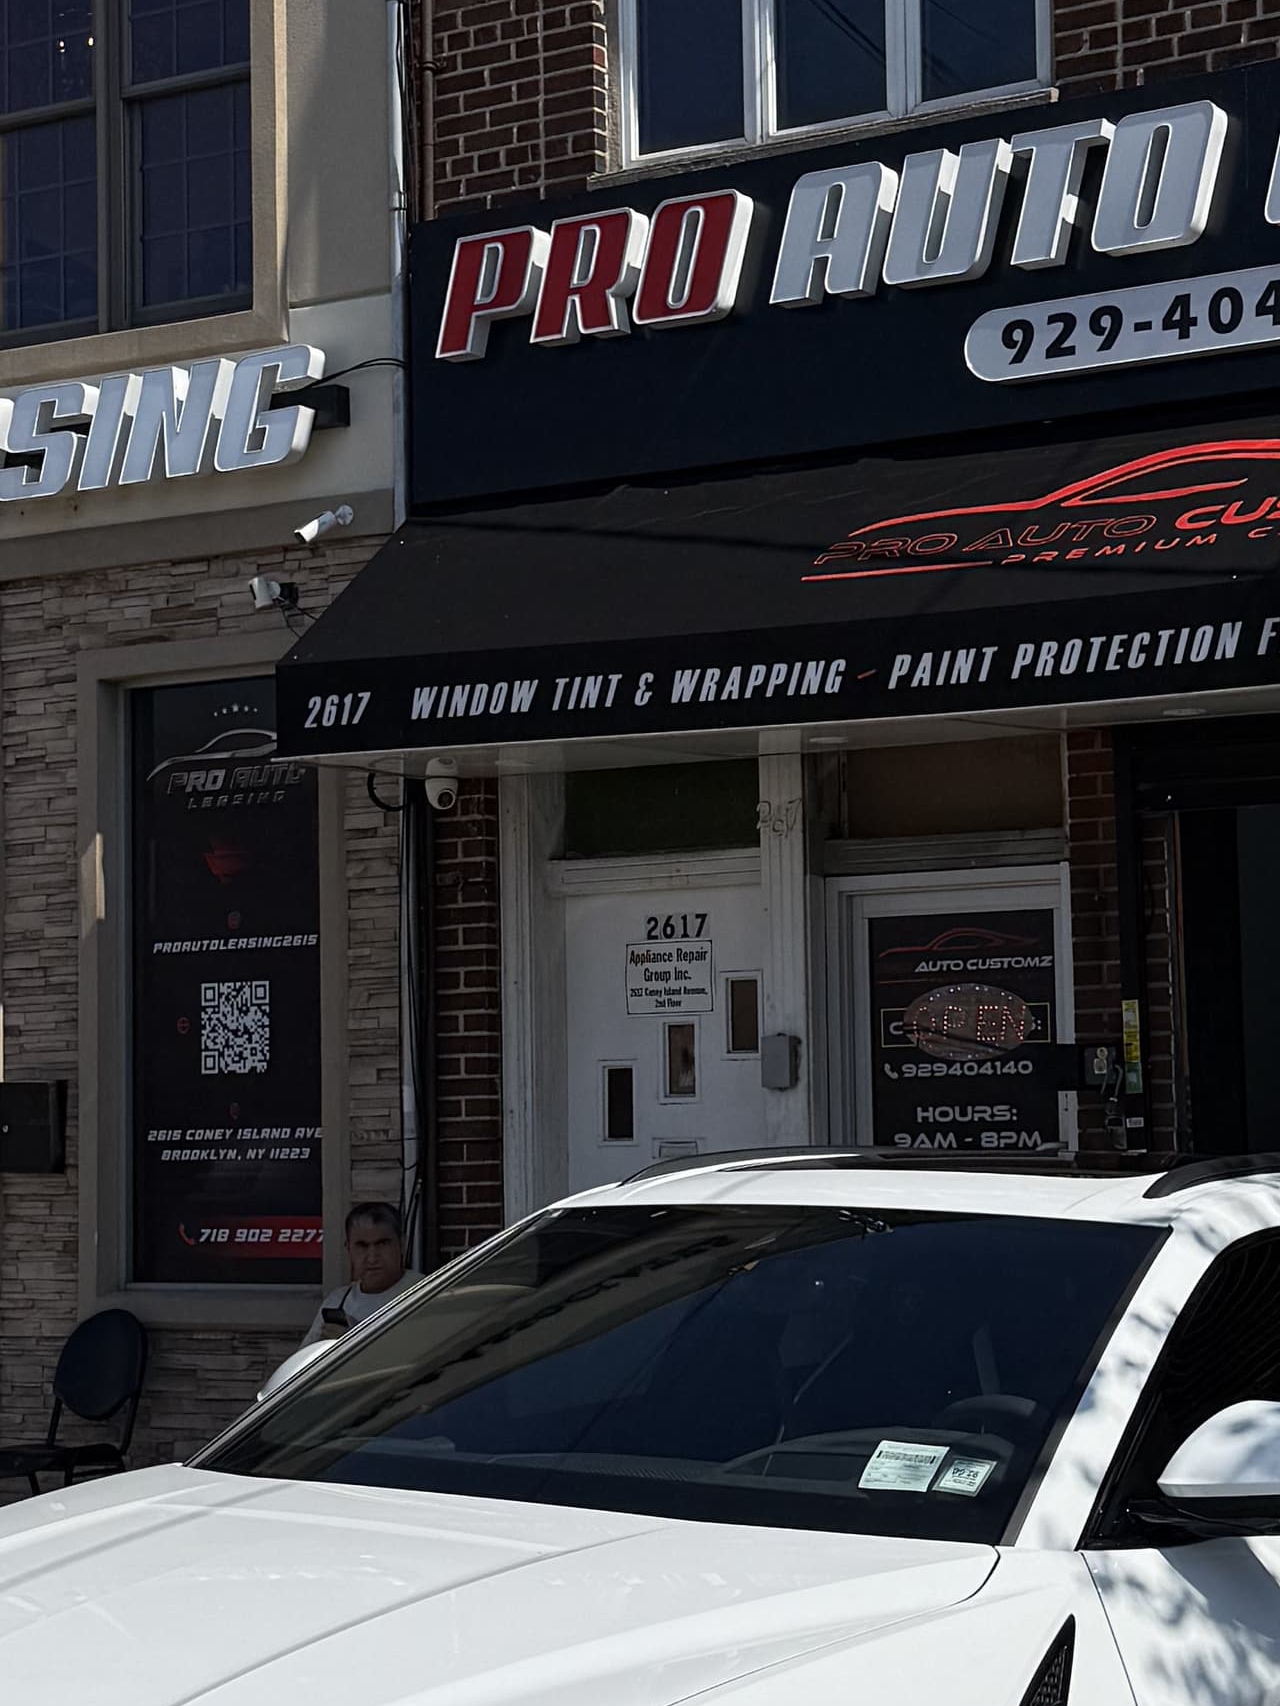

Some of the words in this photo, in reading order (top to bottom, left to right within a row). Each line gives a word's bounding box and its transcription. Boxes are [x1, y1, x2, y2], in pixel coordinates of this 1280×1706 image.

[435, 187, 754, 362] PRO
[769, 99, 1228, 306] AUTO
[812, 533, 958, 565] PRO
[967, 514, 1158, 551] AUTO
[1001, 533, 1219, 565] PREMIUM
[304, 691, 371, 729] 2617
[410, 678, 540, 721] WINDOW
[552, 673, 623, 712] TINT
[634, 671, 654, 707] &
[671, 658, 847, 704] WRAPPING
[888, 646, 998, 690] PAINT
[1011, 621, 1243, 680] PROTECTION
[167, 769, 226, 794] PRO
[188, 791, 286, 809] LEASING
[646, 913, 708, 941] 2617
[153, 933, 318, 954] PROAUTOLEASING2615
[629, 949, 673, 967] Appliance
[676, 946, 708, 964] Repair
[914, 959, 964, 973] AUTO
[966, 955, 1055, 970] CUSTOMZ
[644, 967, 671, 983] Group
[674, 967, 692, 981] Inc.
[901, 1060, 1033, 1078] 929404140
[917, 1105, 1018, 1124] HOURS:
[147, 1129, 181, 1141] 2615
[185, 1128, 233, 1140] CONEY
[237, 1127, 291, 1139] ISLAND
[294, 1126, 322, 1139] AVE
[894, 1132, 958, 1149] 9AM
[980, 1131, 1042, 1149] 8PM
[161, 1149, 242, 1161] BROOKLYN,
[246, 1148, 266, 1159] NY
[270, 1147, 311, 1160] 11223
[199, 1228, 230, 1242] 718
[234, 1228, 272, 1242] 902
